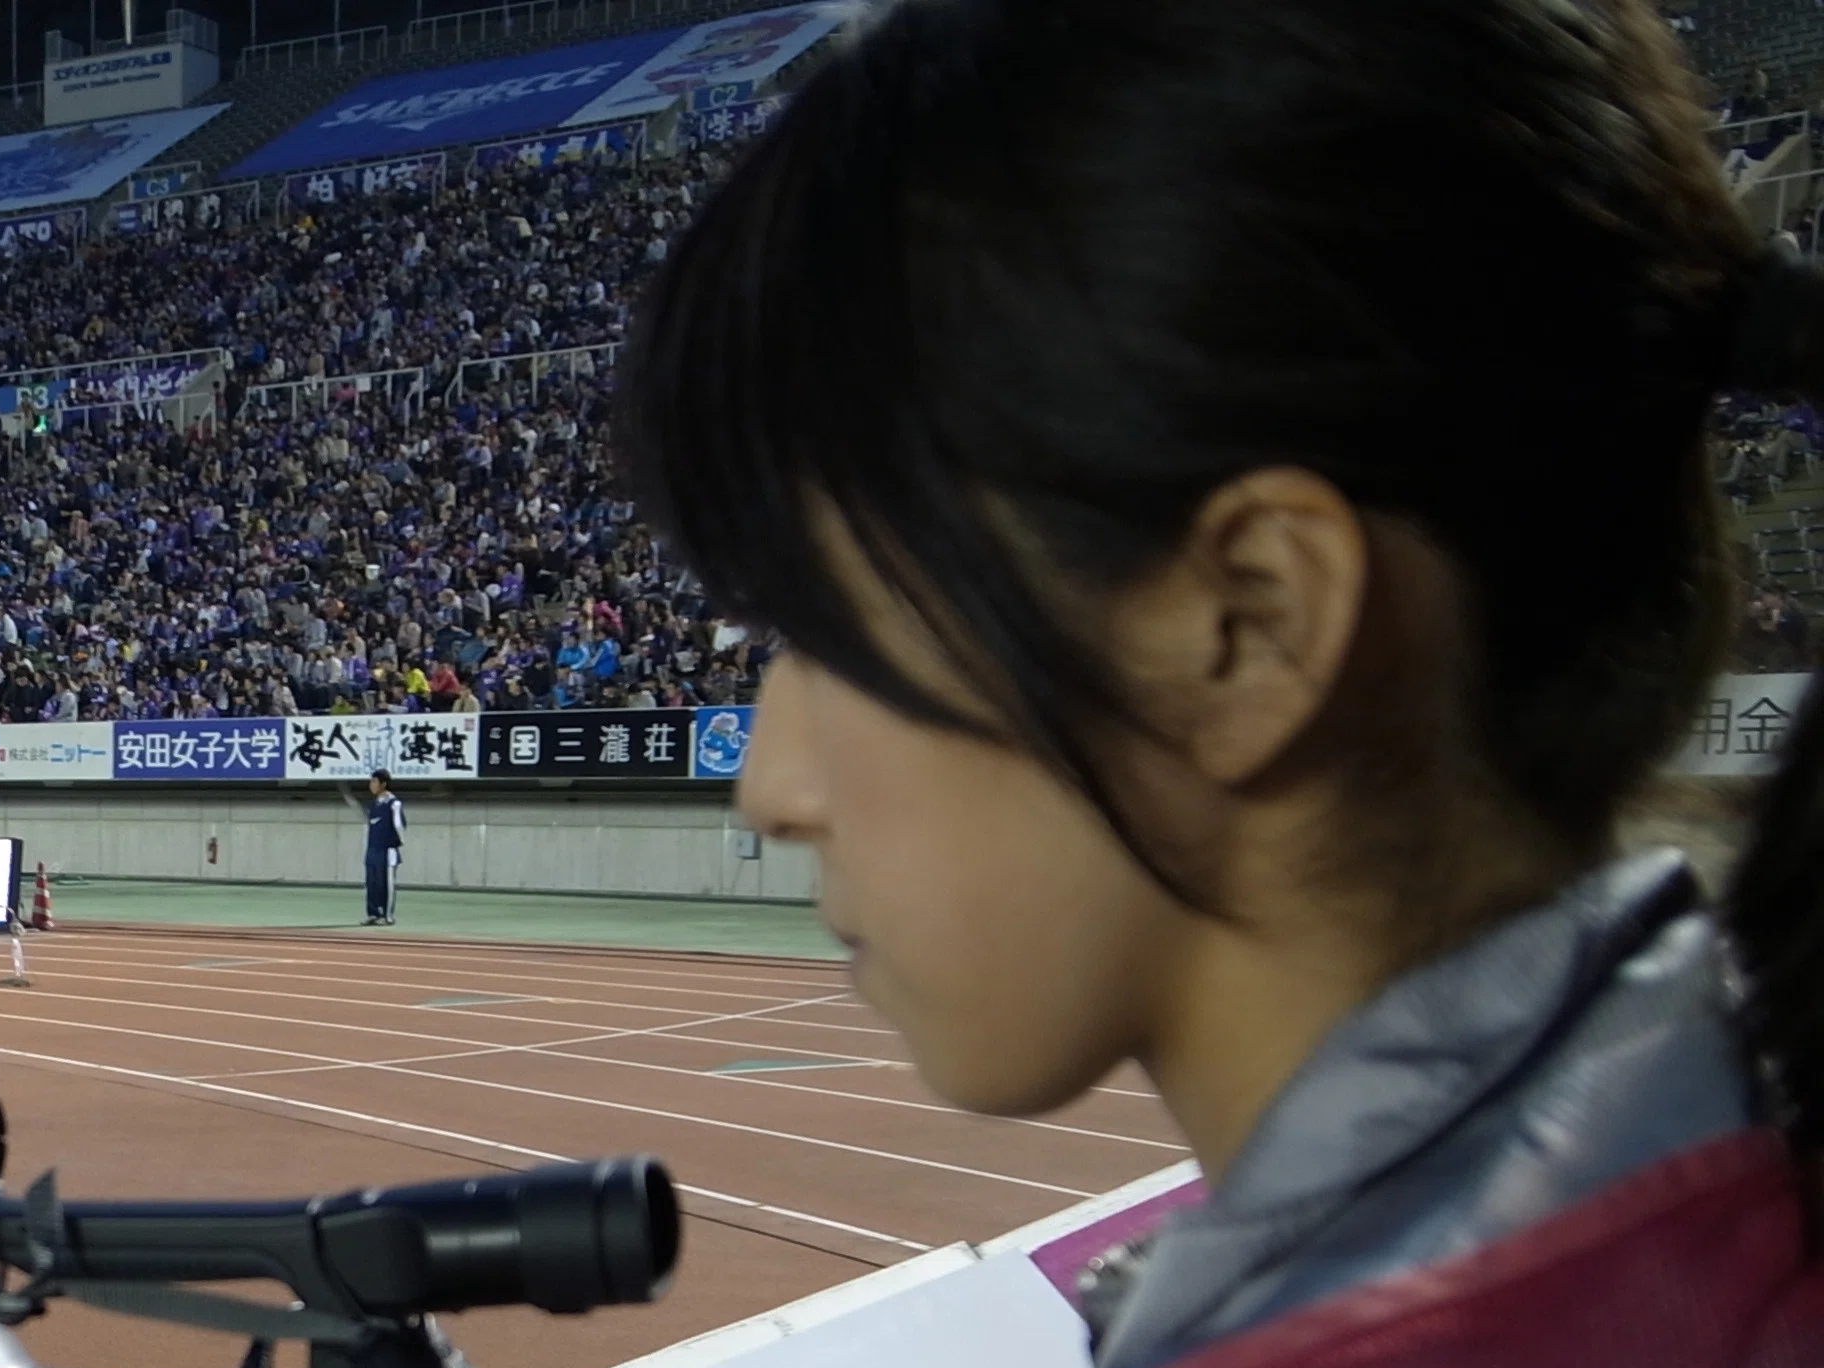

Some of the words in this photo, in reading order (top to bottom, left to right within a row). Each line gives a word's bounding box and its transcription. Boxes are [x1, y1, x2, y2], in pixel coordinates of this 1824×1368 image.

[709, 85, 738, 106] C2
[146, 178, 170, 197] C3
[117, 727, 280, 770] 安田女子大学
